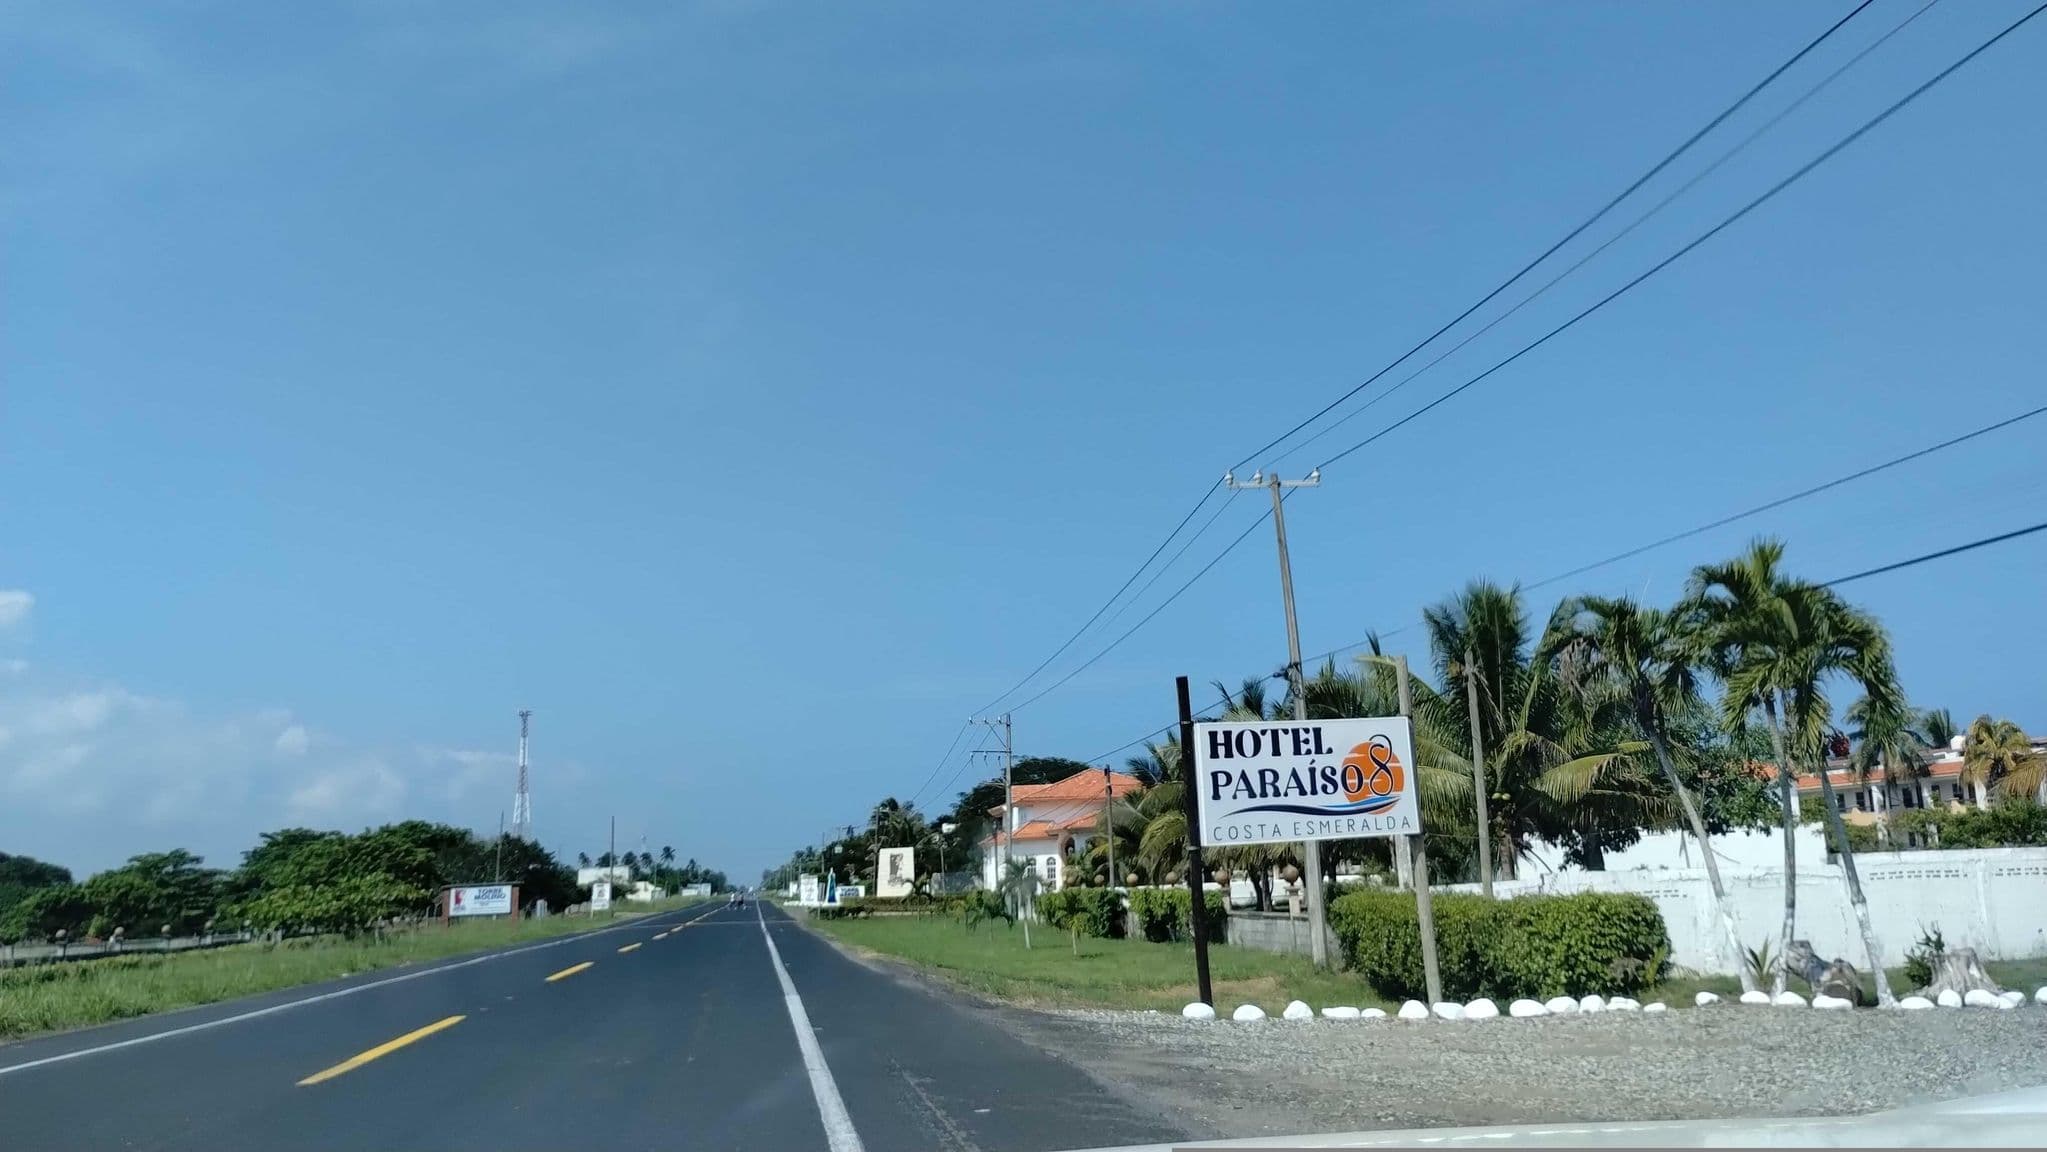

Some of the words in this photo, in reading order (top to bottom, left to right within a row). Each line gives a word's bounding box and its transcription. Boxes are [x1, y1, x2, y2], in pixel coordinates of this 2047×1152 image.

[1208, 727, 1333, 759] HOTEL
[1210, 759, 1364, 801] PARAÍSO
[1213, 823, 1282, 841] COSTA
[1293, 815, 1411, 836] ESMERALDA
